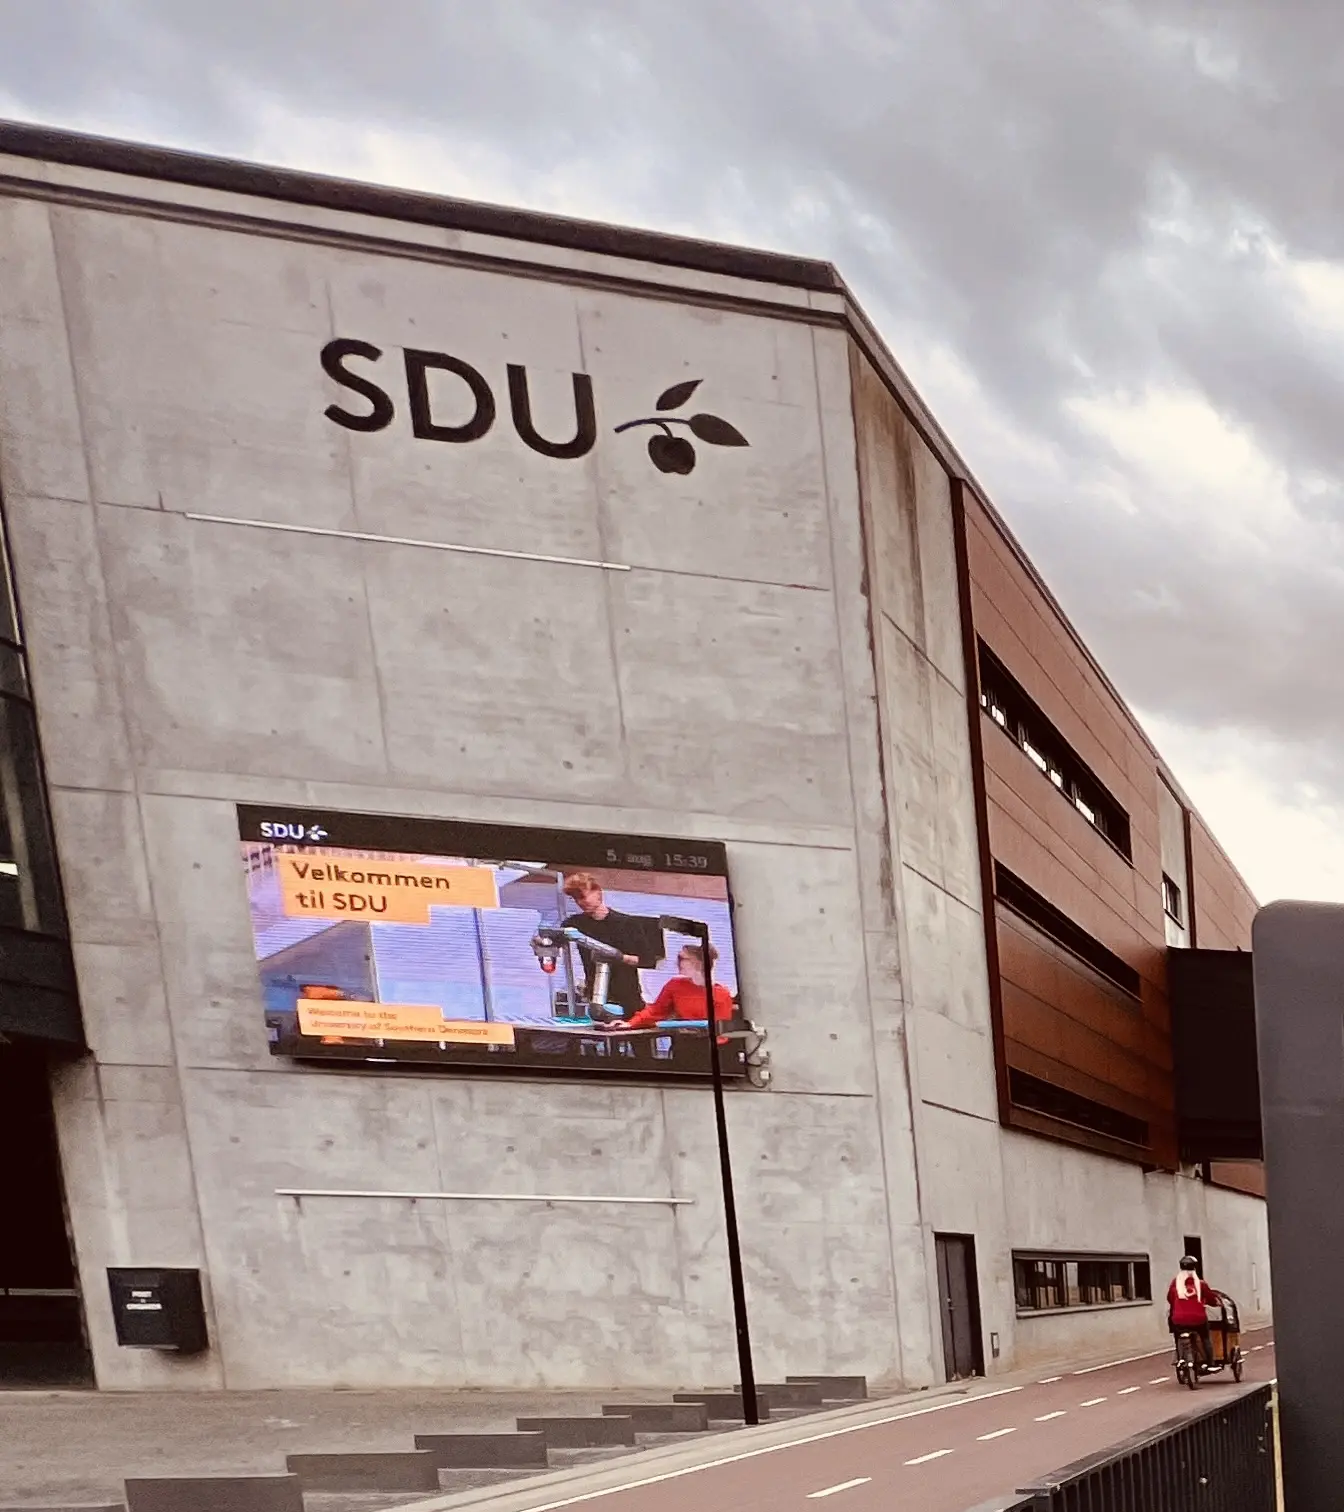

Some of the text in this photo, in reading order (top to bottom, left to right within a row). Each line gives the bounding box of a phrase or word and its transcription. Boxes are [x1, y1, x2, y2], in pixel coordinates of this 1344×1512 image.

[320, 337, 597, 459] SDU
[260, 822, 304, 840] SDU
[291, 860, 450, 890] Velkommen
[296, 892, 388, 914] til SDU
